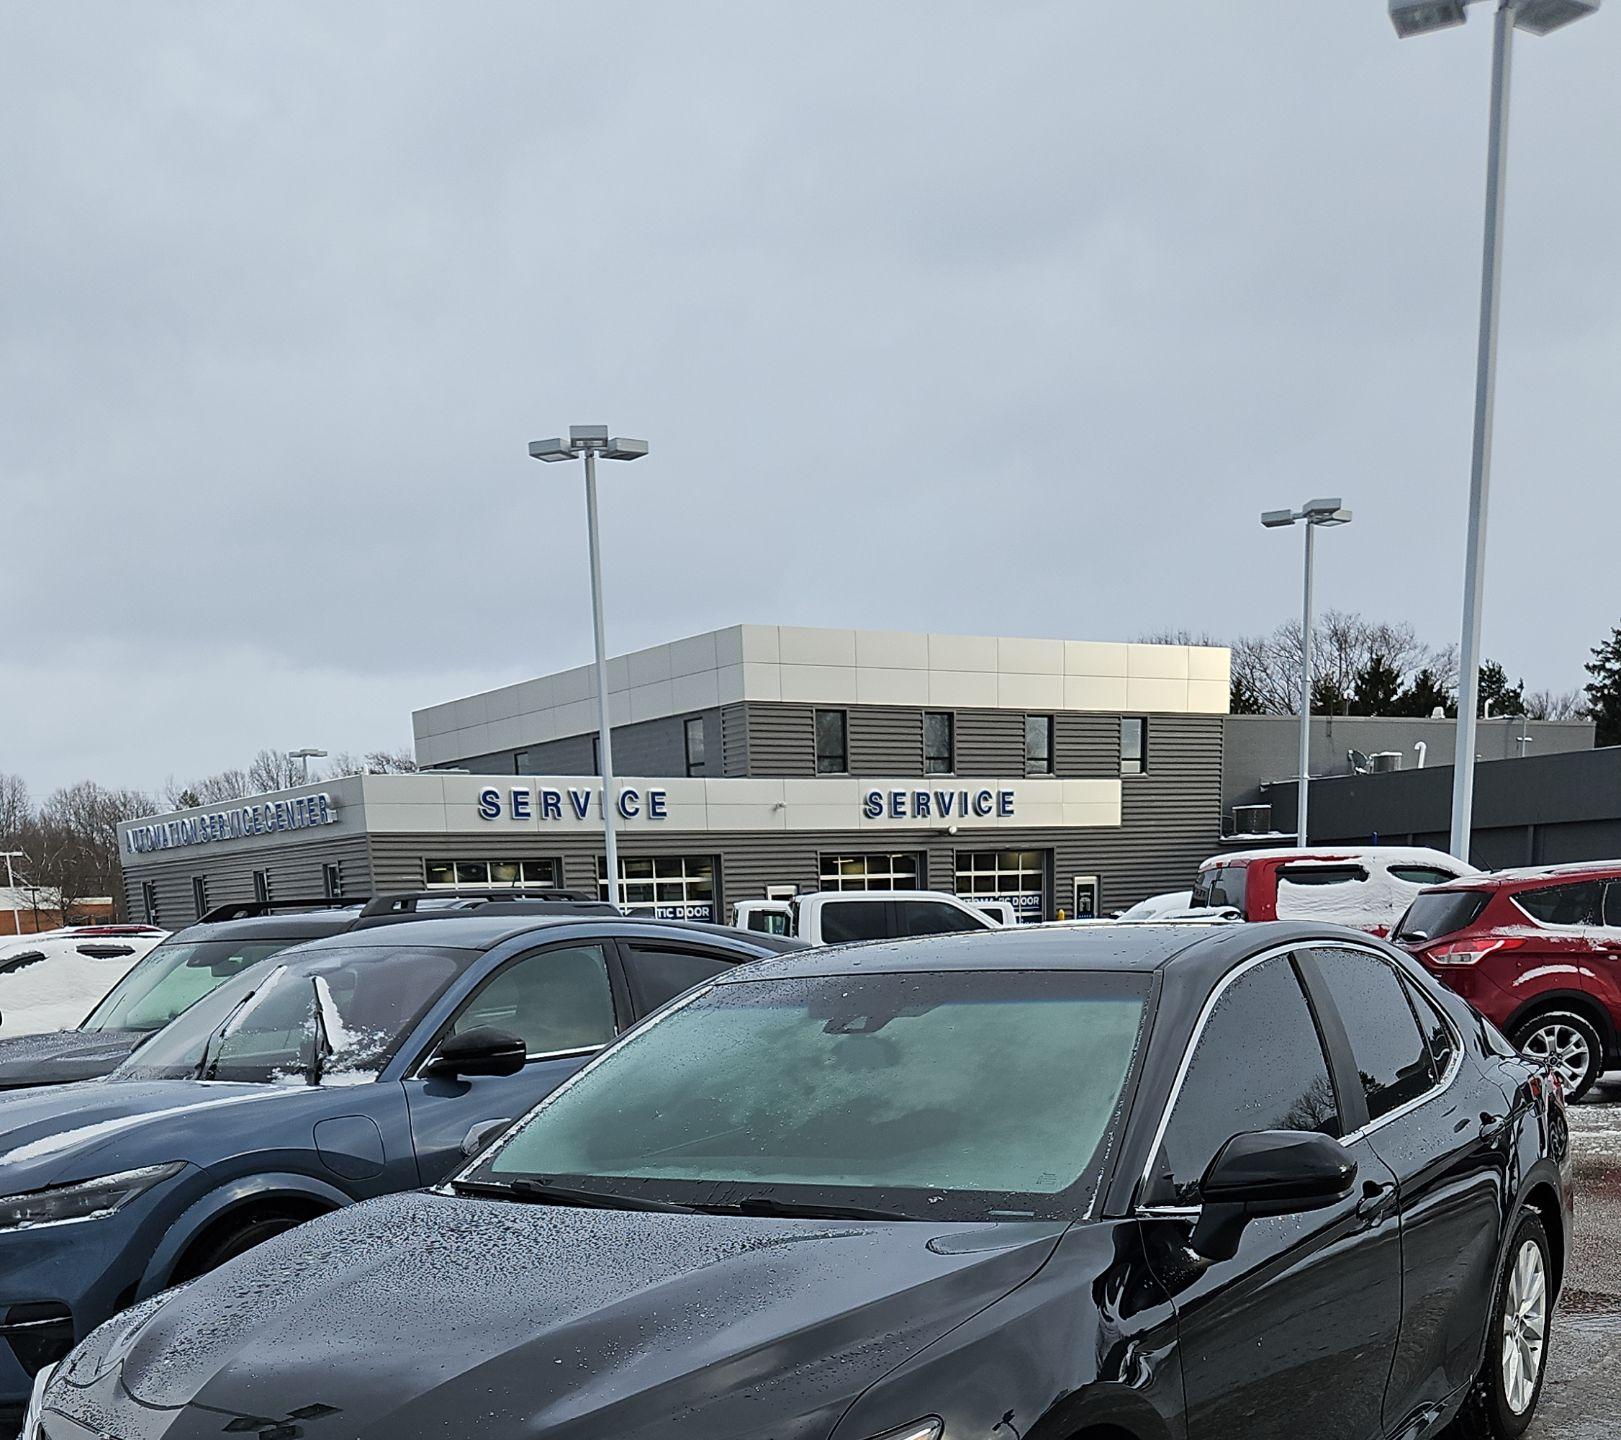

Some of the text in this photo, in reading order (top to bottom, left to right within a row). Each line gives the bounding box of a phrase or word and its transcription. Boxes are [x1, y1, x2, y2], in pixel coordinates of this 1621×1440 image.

[199, 804, 265, 843] SERVICE
[264, 792, 337, 833] CENTER
[479, 786, 668, 820] SERVCE
[863, 788, 1015, 819] SERVICE
[676, 906, 710, 918] DOOR
[1012, 896, 1040, 906] DOOR
